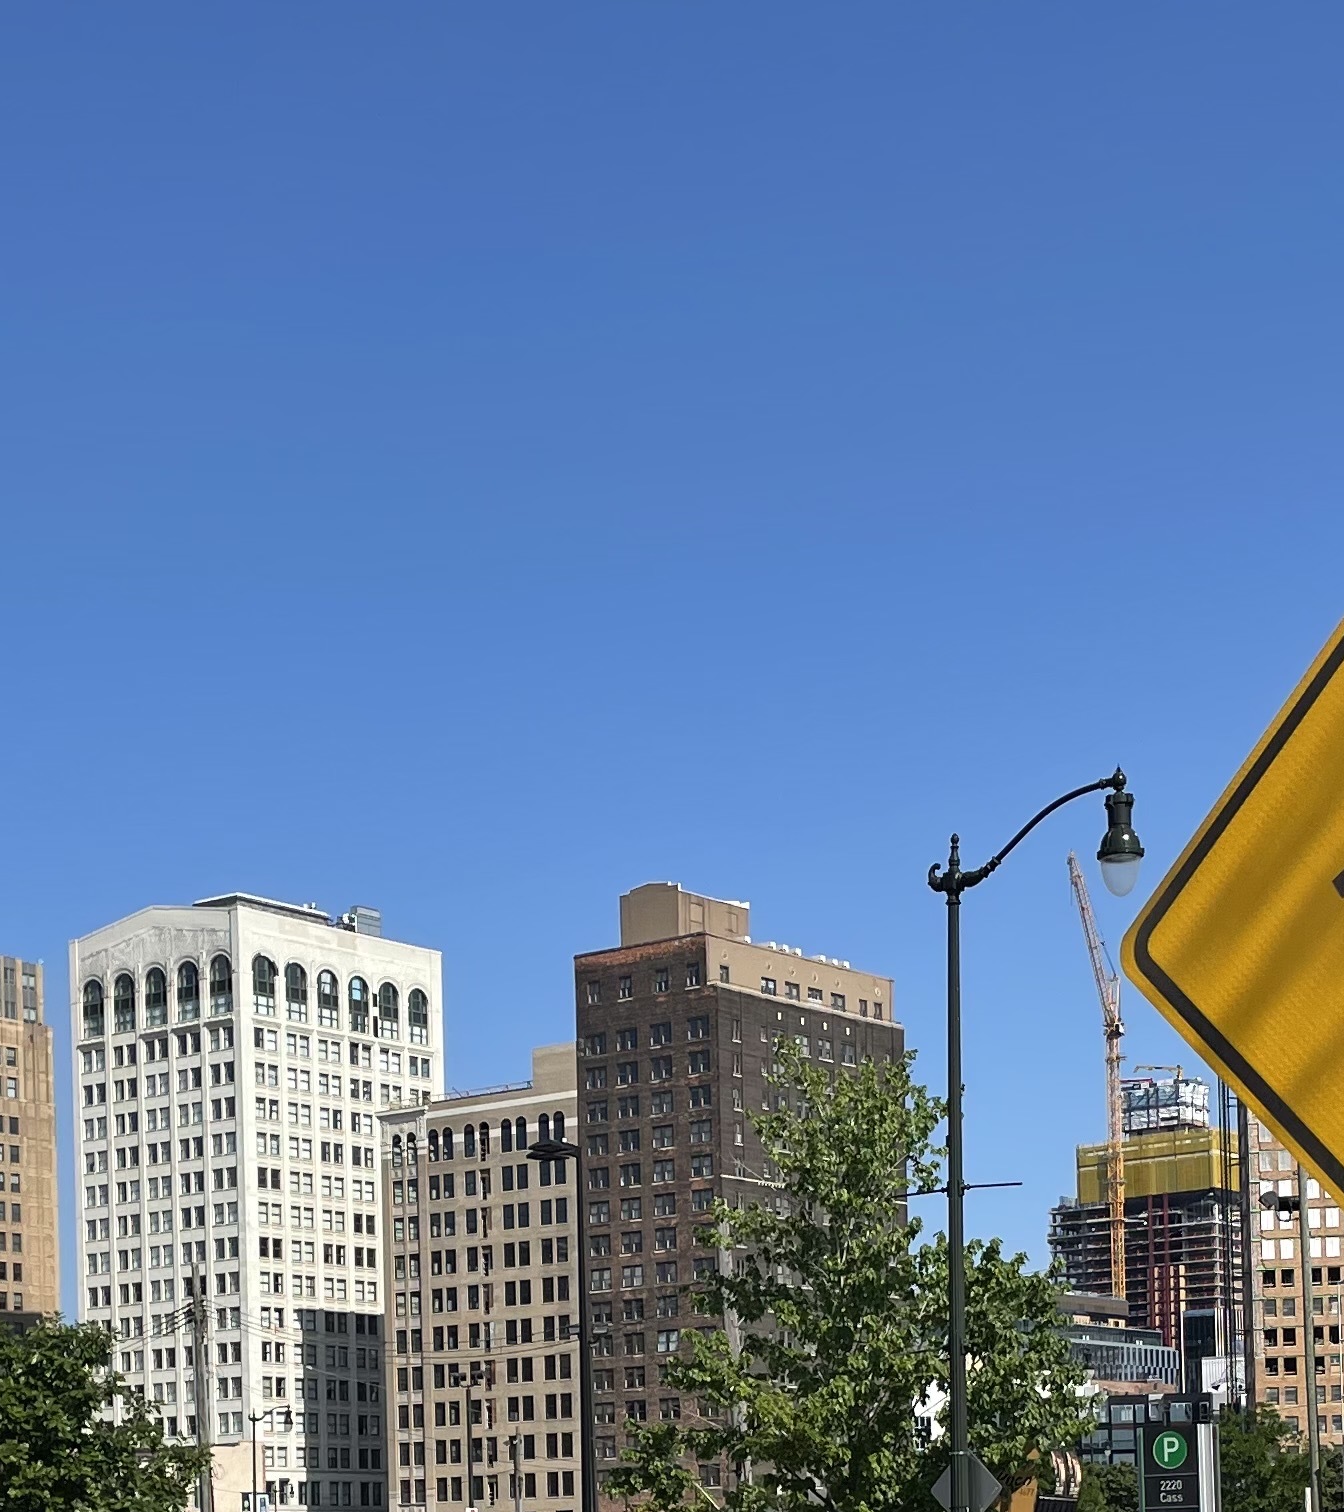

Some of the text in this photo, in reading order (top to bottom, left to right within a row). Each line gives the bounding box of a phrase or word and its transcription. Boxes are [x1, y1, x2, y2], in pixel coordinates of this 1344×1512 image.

[1163, 1437, 1179, 1462] P
[1160, 1480, 1183, 1491] 2220
[1160, 1492, 1183, 1503] Cass
